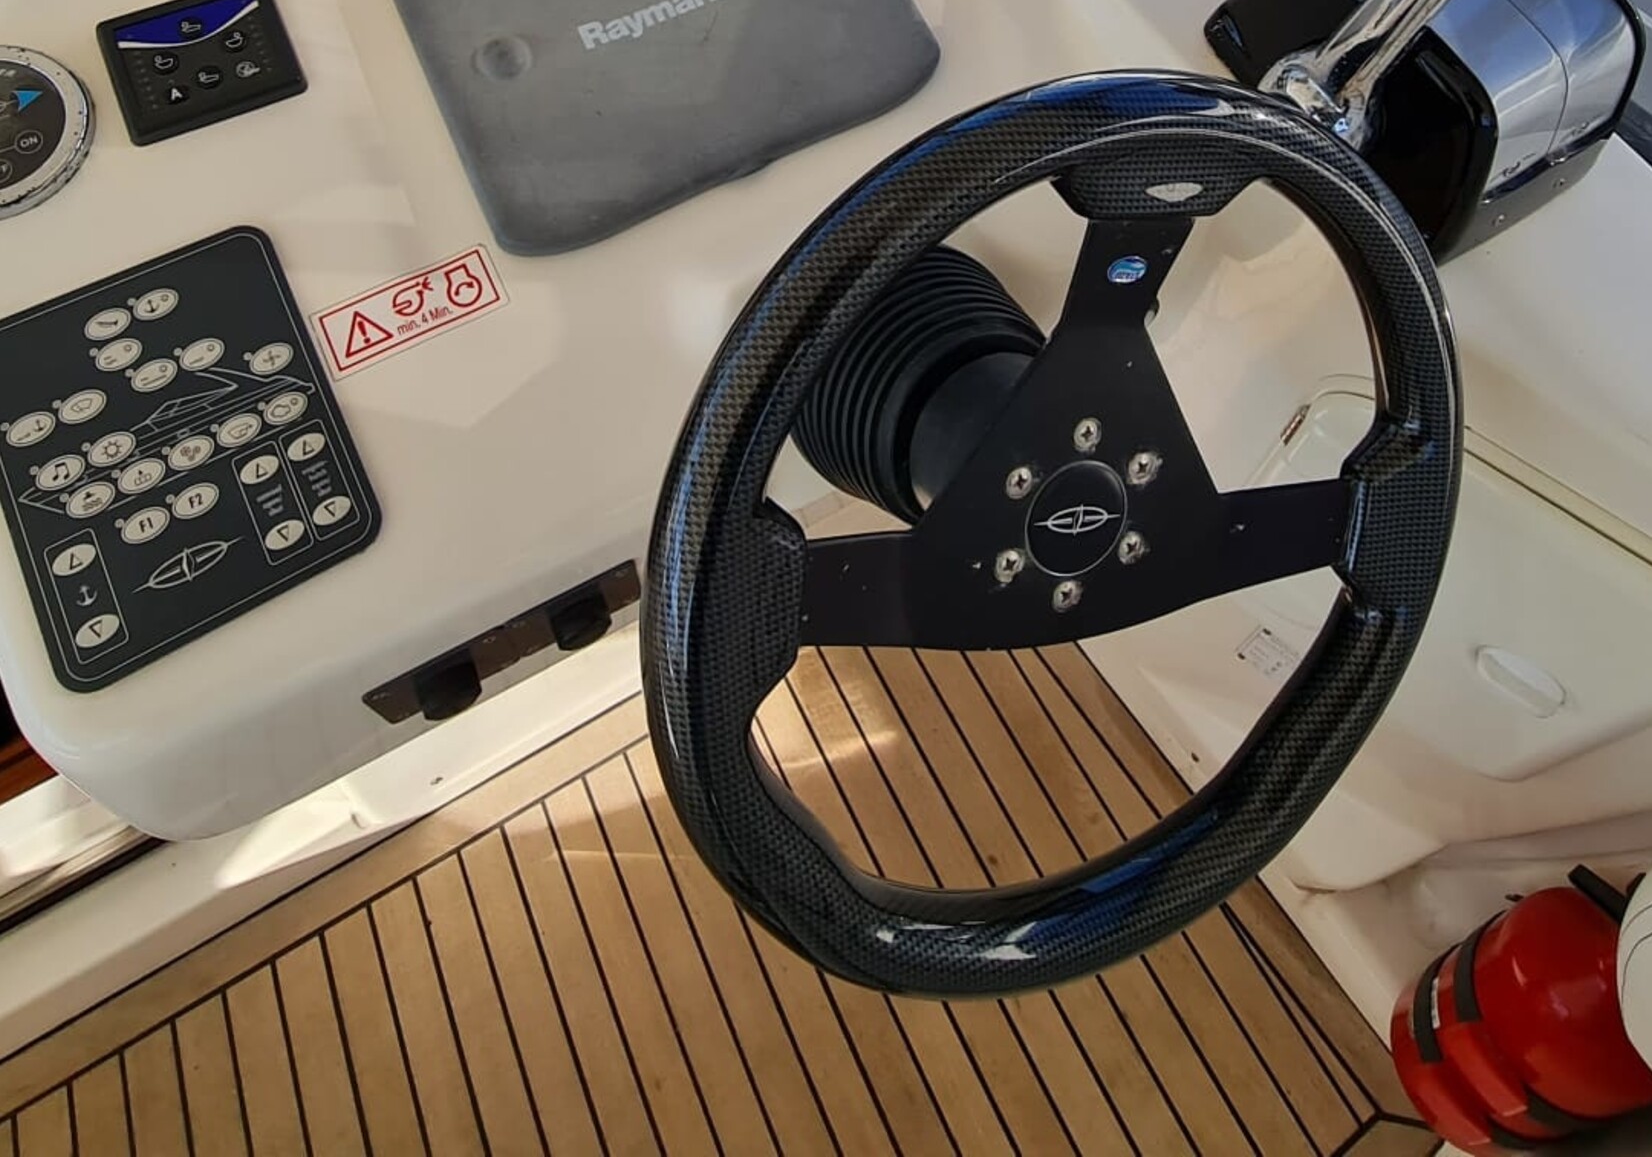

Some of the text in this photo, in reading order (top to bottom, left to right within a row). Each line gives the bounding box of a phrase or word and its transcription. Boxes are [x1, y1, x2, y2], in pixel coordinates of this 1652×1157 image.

[20, 135, 38, 148] ON
[397, 306, 453, 335] min. 4 Min.
[188, 492, 204, 509] F2
[139, 516, 154, 534] F1
